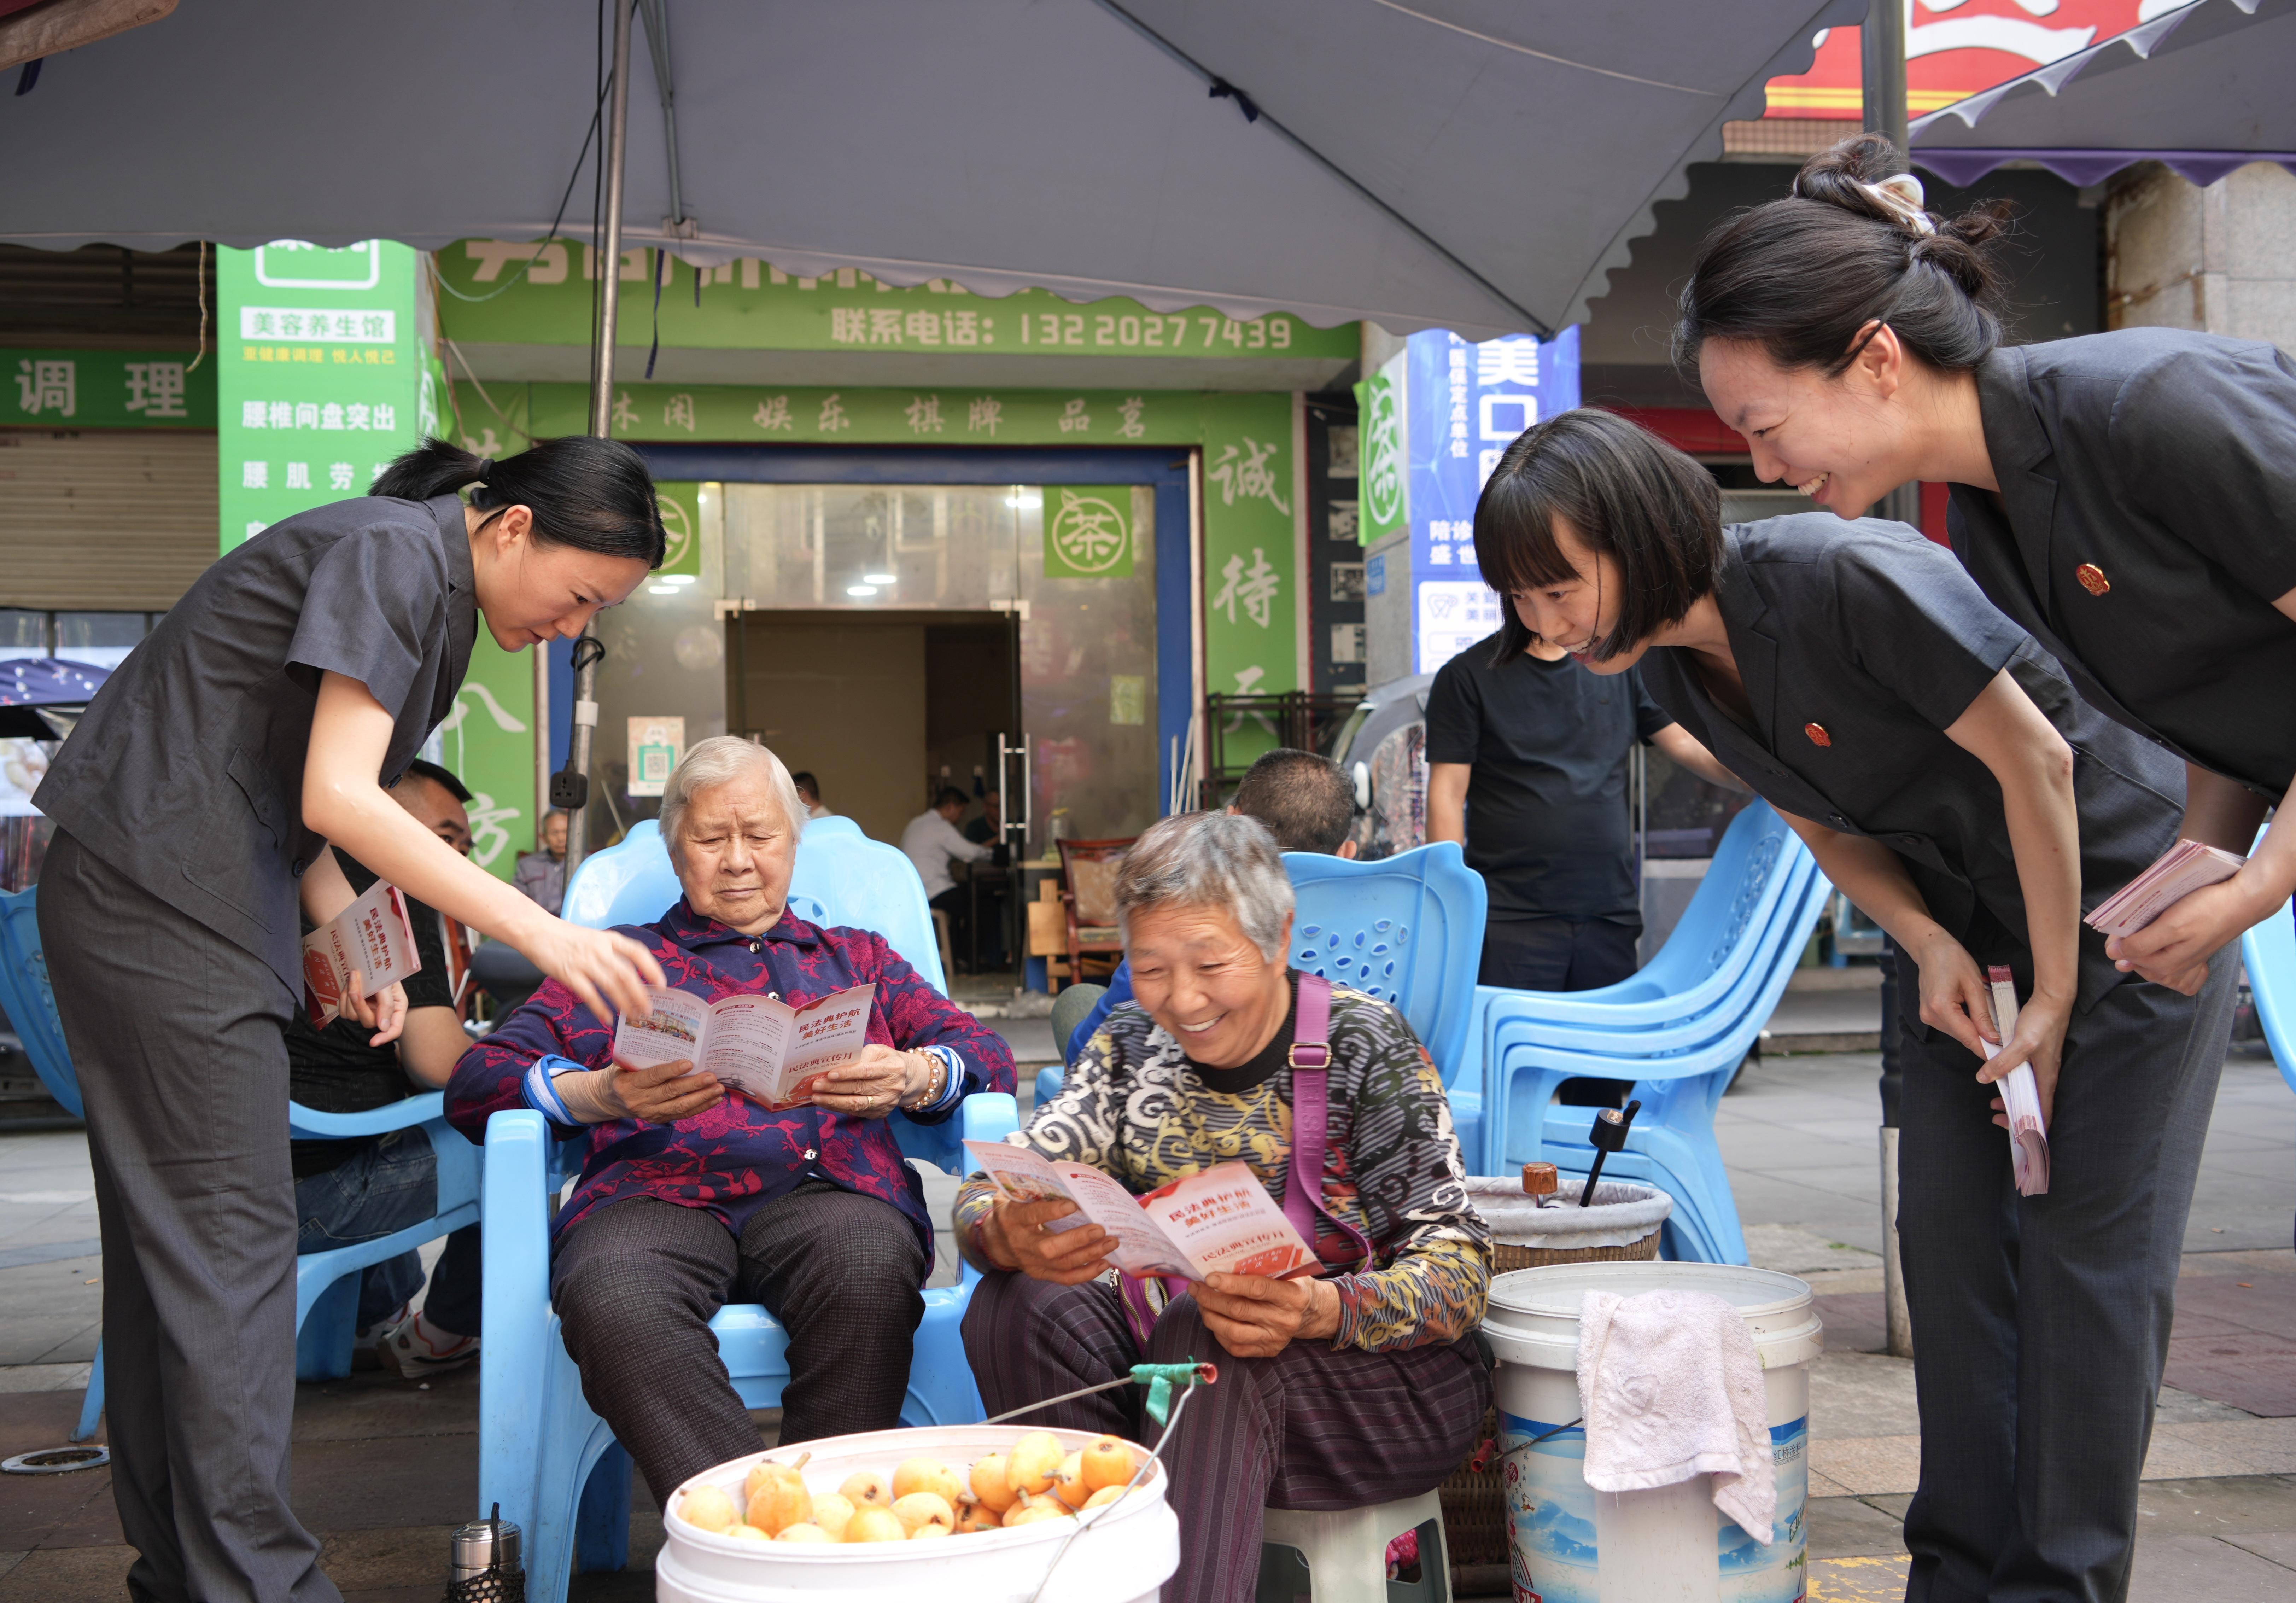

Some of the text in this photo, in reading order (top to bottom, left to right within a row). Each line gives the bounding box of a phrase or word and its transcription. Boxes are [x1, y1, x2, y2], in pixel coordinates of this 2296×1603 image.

[252, 312, 385, 338] 美容养生馆
[243, 346, 396, 364] 亚健康调理 悦人悦己
[15, 359, 188, 418] 调理
[242, 401, 396, 431] 腰椎间盘突出
[1477, 338, 1539, 495] 美口
[1061, 511, 1120, 561] 茶
[363, 919, 382, 969] 美好生活
[369, 907, 392, 971] 民法典护航
[798, 1008, 861, 1033] 民法典护航
[802, 1019, 852, 1040] 美好生活
[789, 1052, 852, 1074] 民法典宣传月
[1169, 1188, 1253, 1222] 民法典护航
[1185, 1200, 1251, 1228] 美好生活
[1774, 1441, 1801, 1461] 红桥涂料
